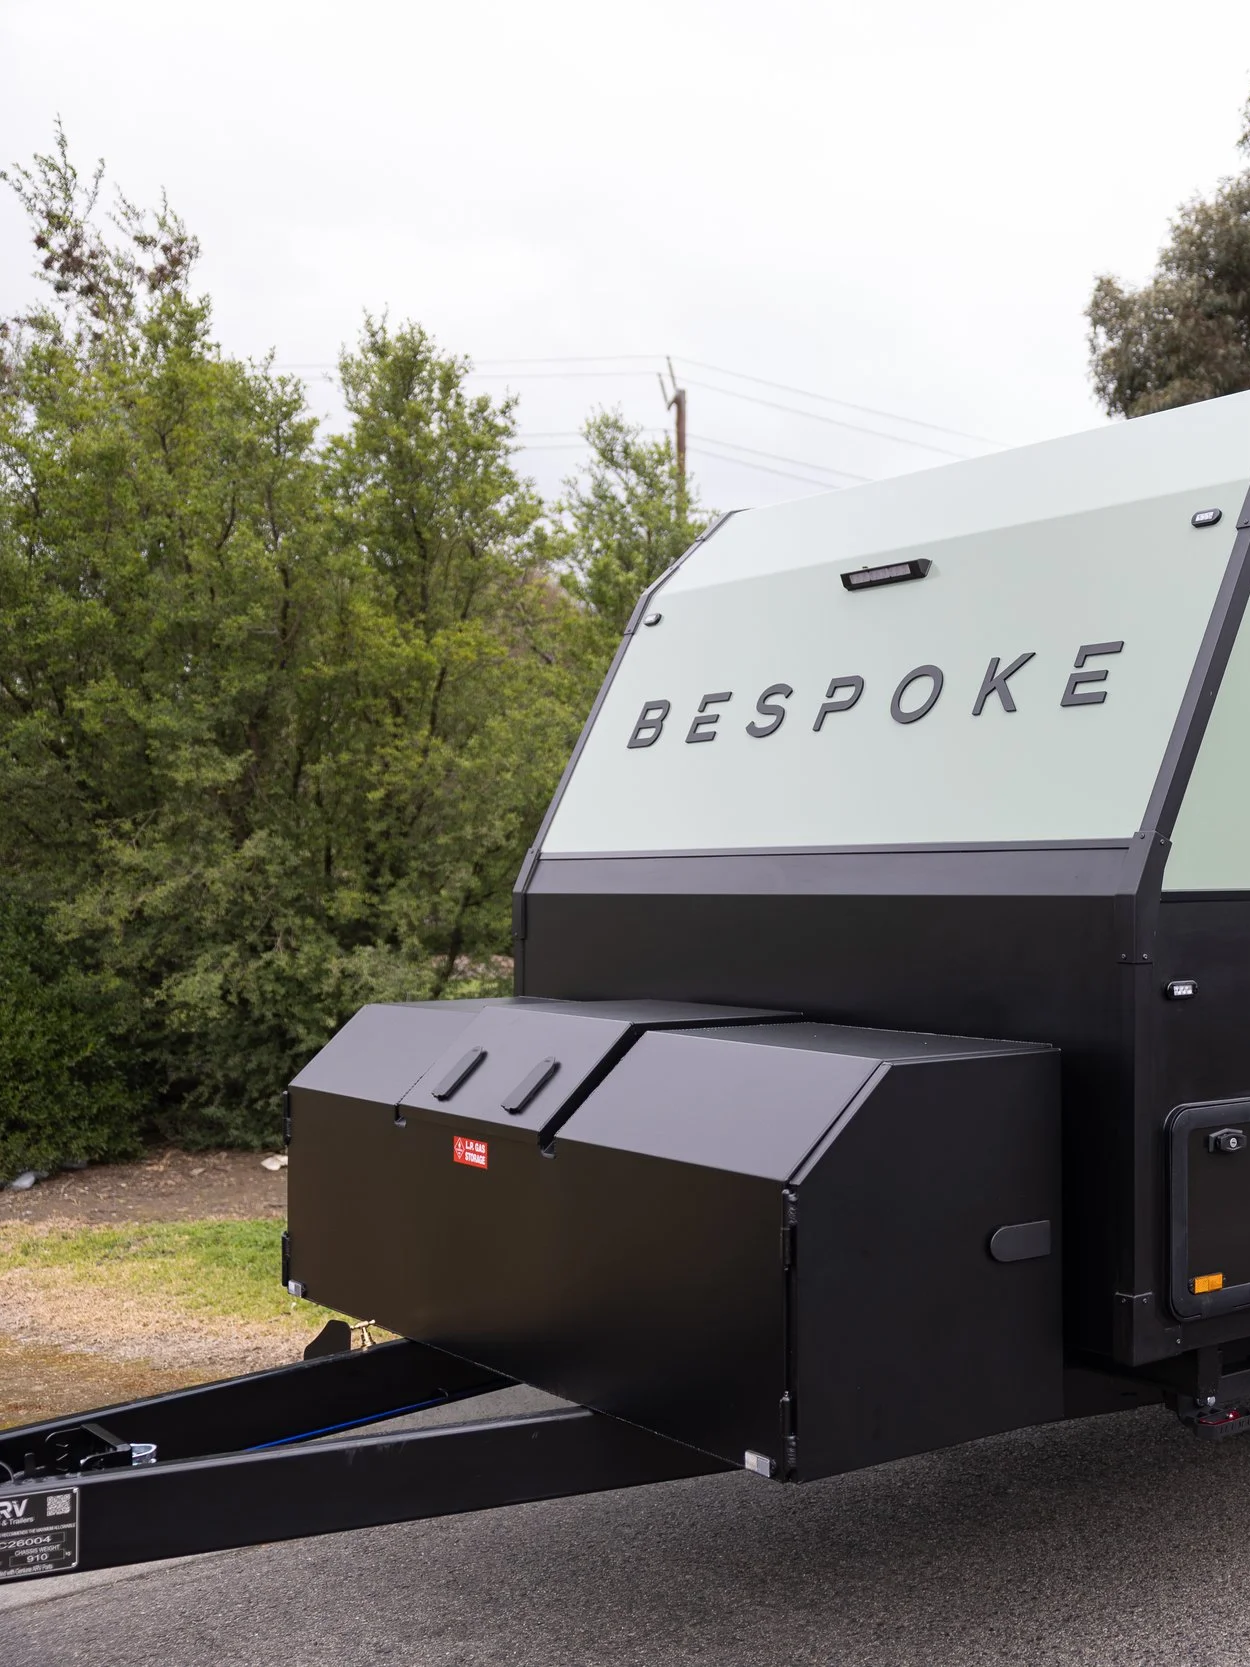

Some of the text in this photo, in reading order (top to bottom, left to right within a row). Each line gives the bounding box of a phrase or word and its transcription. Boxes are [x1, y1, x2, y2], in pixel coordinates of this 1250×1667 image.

[627, 641, 1124, 749] BESPOKE
[475, 1142, 485, 1153] GAS
[465, 1151, 486, 1165] STORAGE
[9, 1517, 34, 1525] Trailers
[14, 1544, 60, 1557] CHASSIS WEIGHT
[26, 1553, 48, 1562] 910
